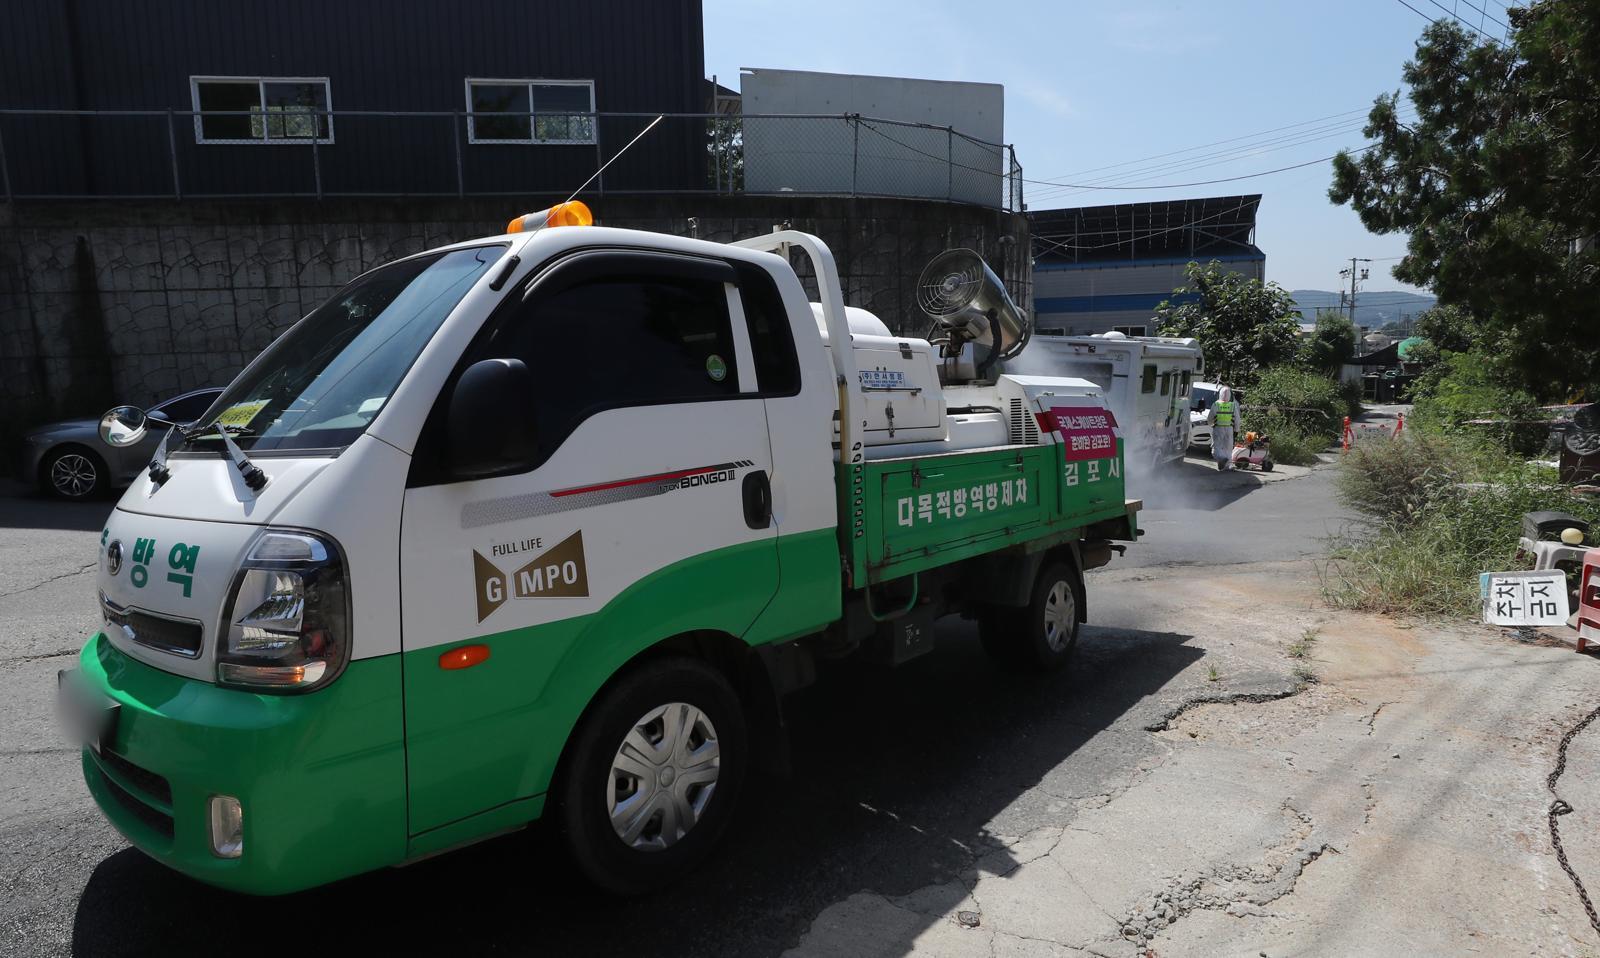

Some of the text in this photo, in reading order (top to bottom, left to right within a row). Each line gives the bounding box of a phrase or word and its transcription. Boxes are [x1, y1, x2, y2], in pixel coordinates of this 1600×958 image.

[1057, 415, 1109, 429] 국제스케이트장은
[1070, 435, 1091, 451] 준비된
[492, 538, 543, 557] FULL LIFE
[130, 537, 200, 598] 방역
[1495, 580, 1522, 618] 주차
[1528, 580, 1558, 618] 금지
